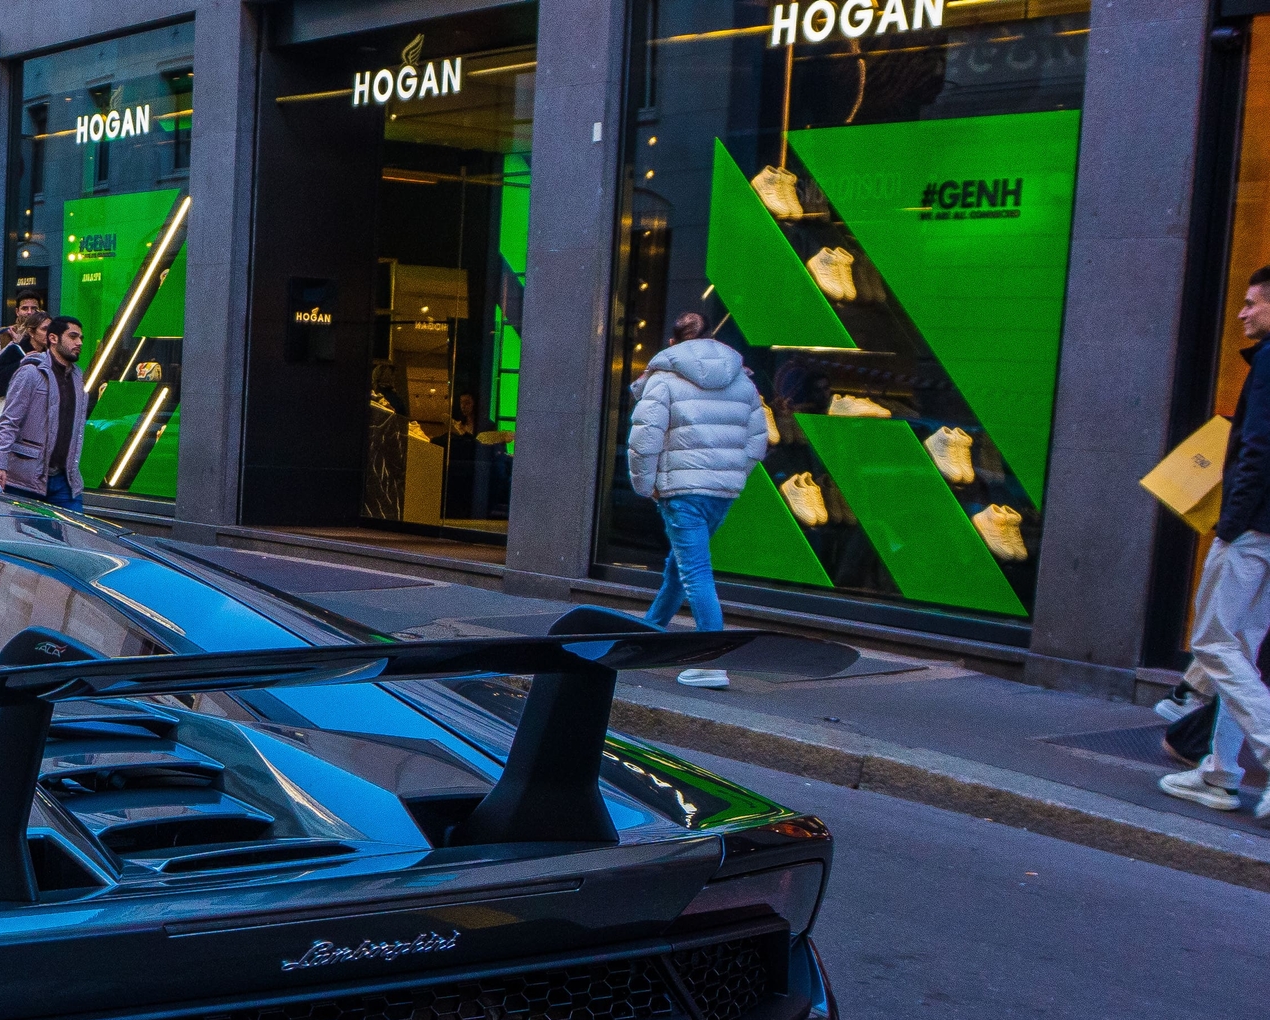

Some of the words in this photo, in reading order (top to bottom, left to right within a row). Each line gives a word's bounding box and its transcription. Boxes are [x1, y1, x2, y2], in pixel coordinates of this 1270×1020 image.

[771, 0, 944, 46] HOGAN
[353, 57, 462, 105] HOGAN
[76, 104, 150, 144] HOGAN
[921, 177, 1023, 210] #GENH
[296, 312, 331, 323] HOGAN
[281, 929, 461, 972] Lamborghini
